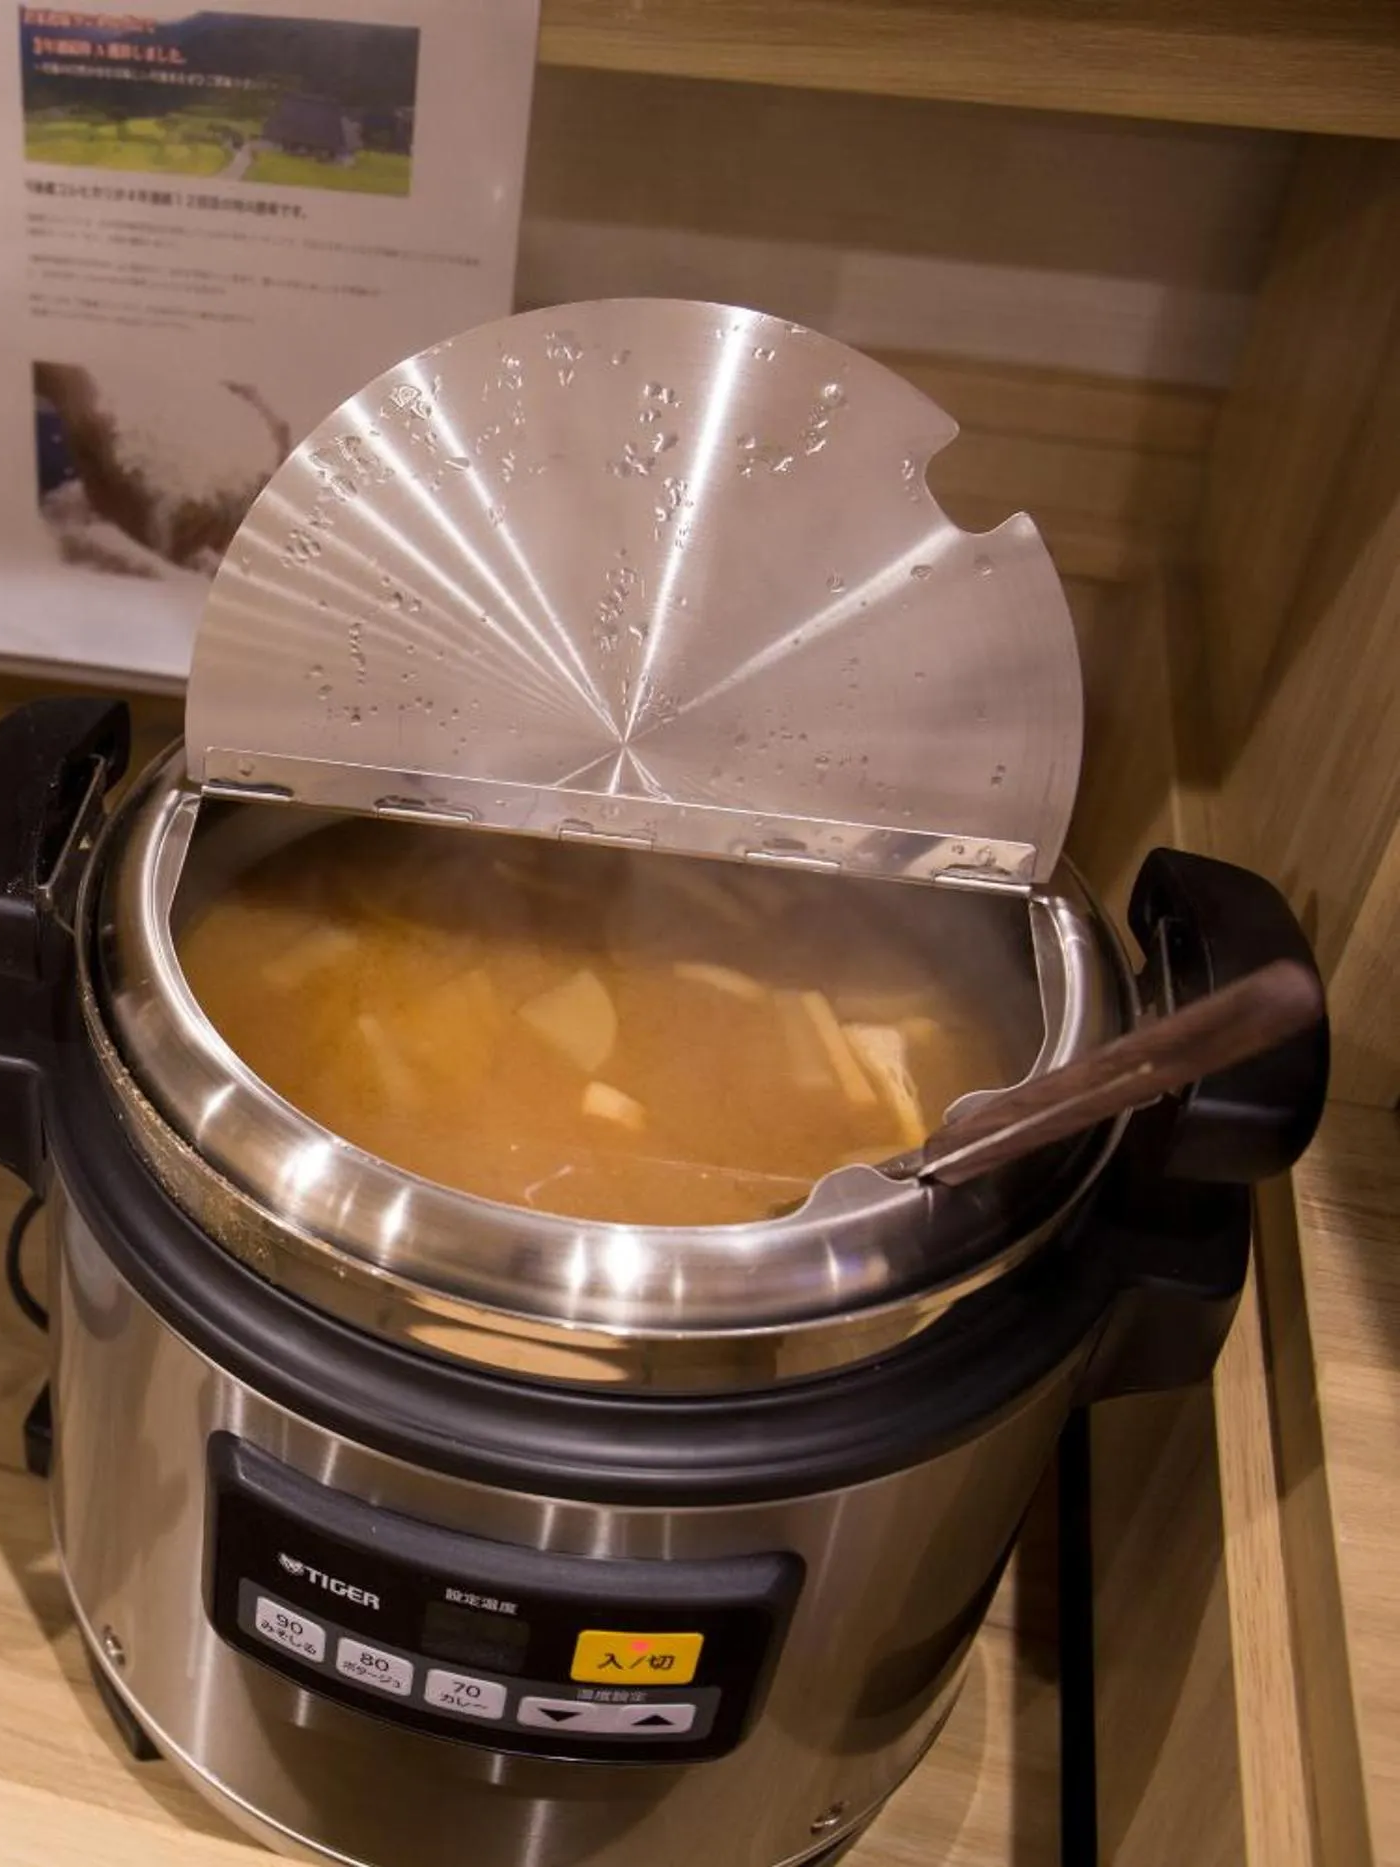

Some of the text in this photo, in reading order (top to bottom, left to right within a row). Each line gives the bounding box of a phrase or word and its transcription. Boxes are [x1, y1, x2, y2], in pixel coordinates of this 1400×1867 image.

[304, 1565, 381, 1610] TIGER
[445, 1587, 518, 1616] 設定温度
[275, 1613, 303, 1636] 90
[260, 1619, 318, 1656] みそしる
[359, 1652, 389, 1672] 80
[342, 1661, 402, 1689] ポタージュ
[452, 1681, 481, 1698] 70
[440, 1694, 489, 1711] カレー
